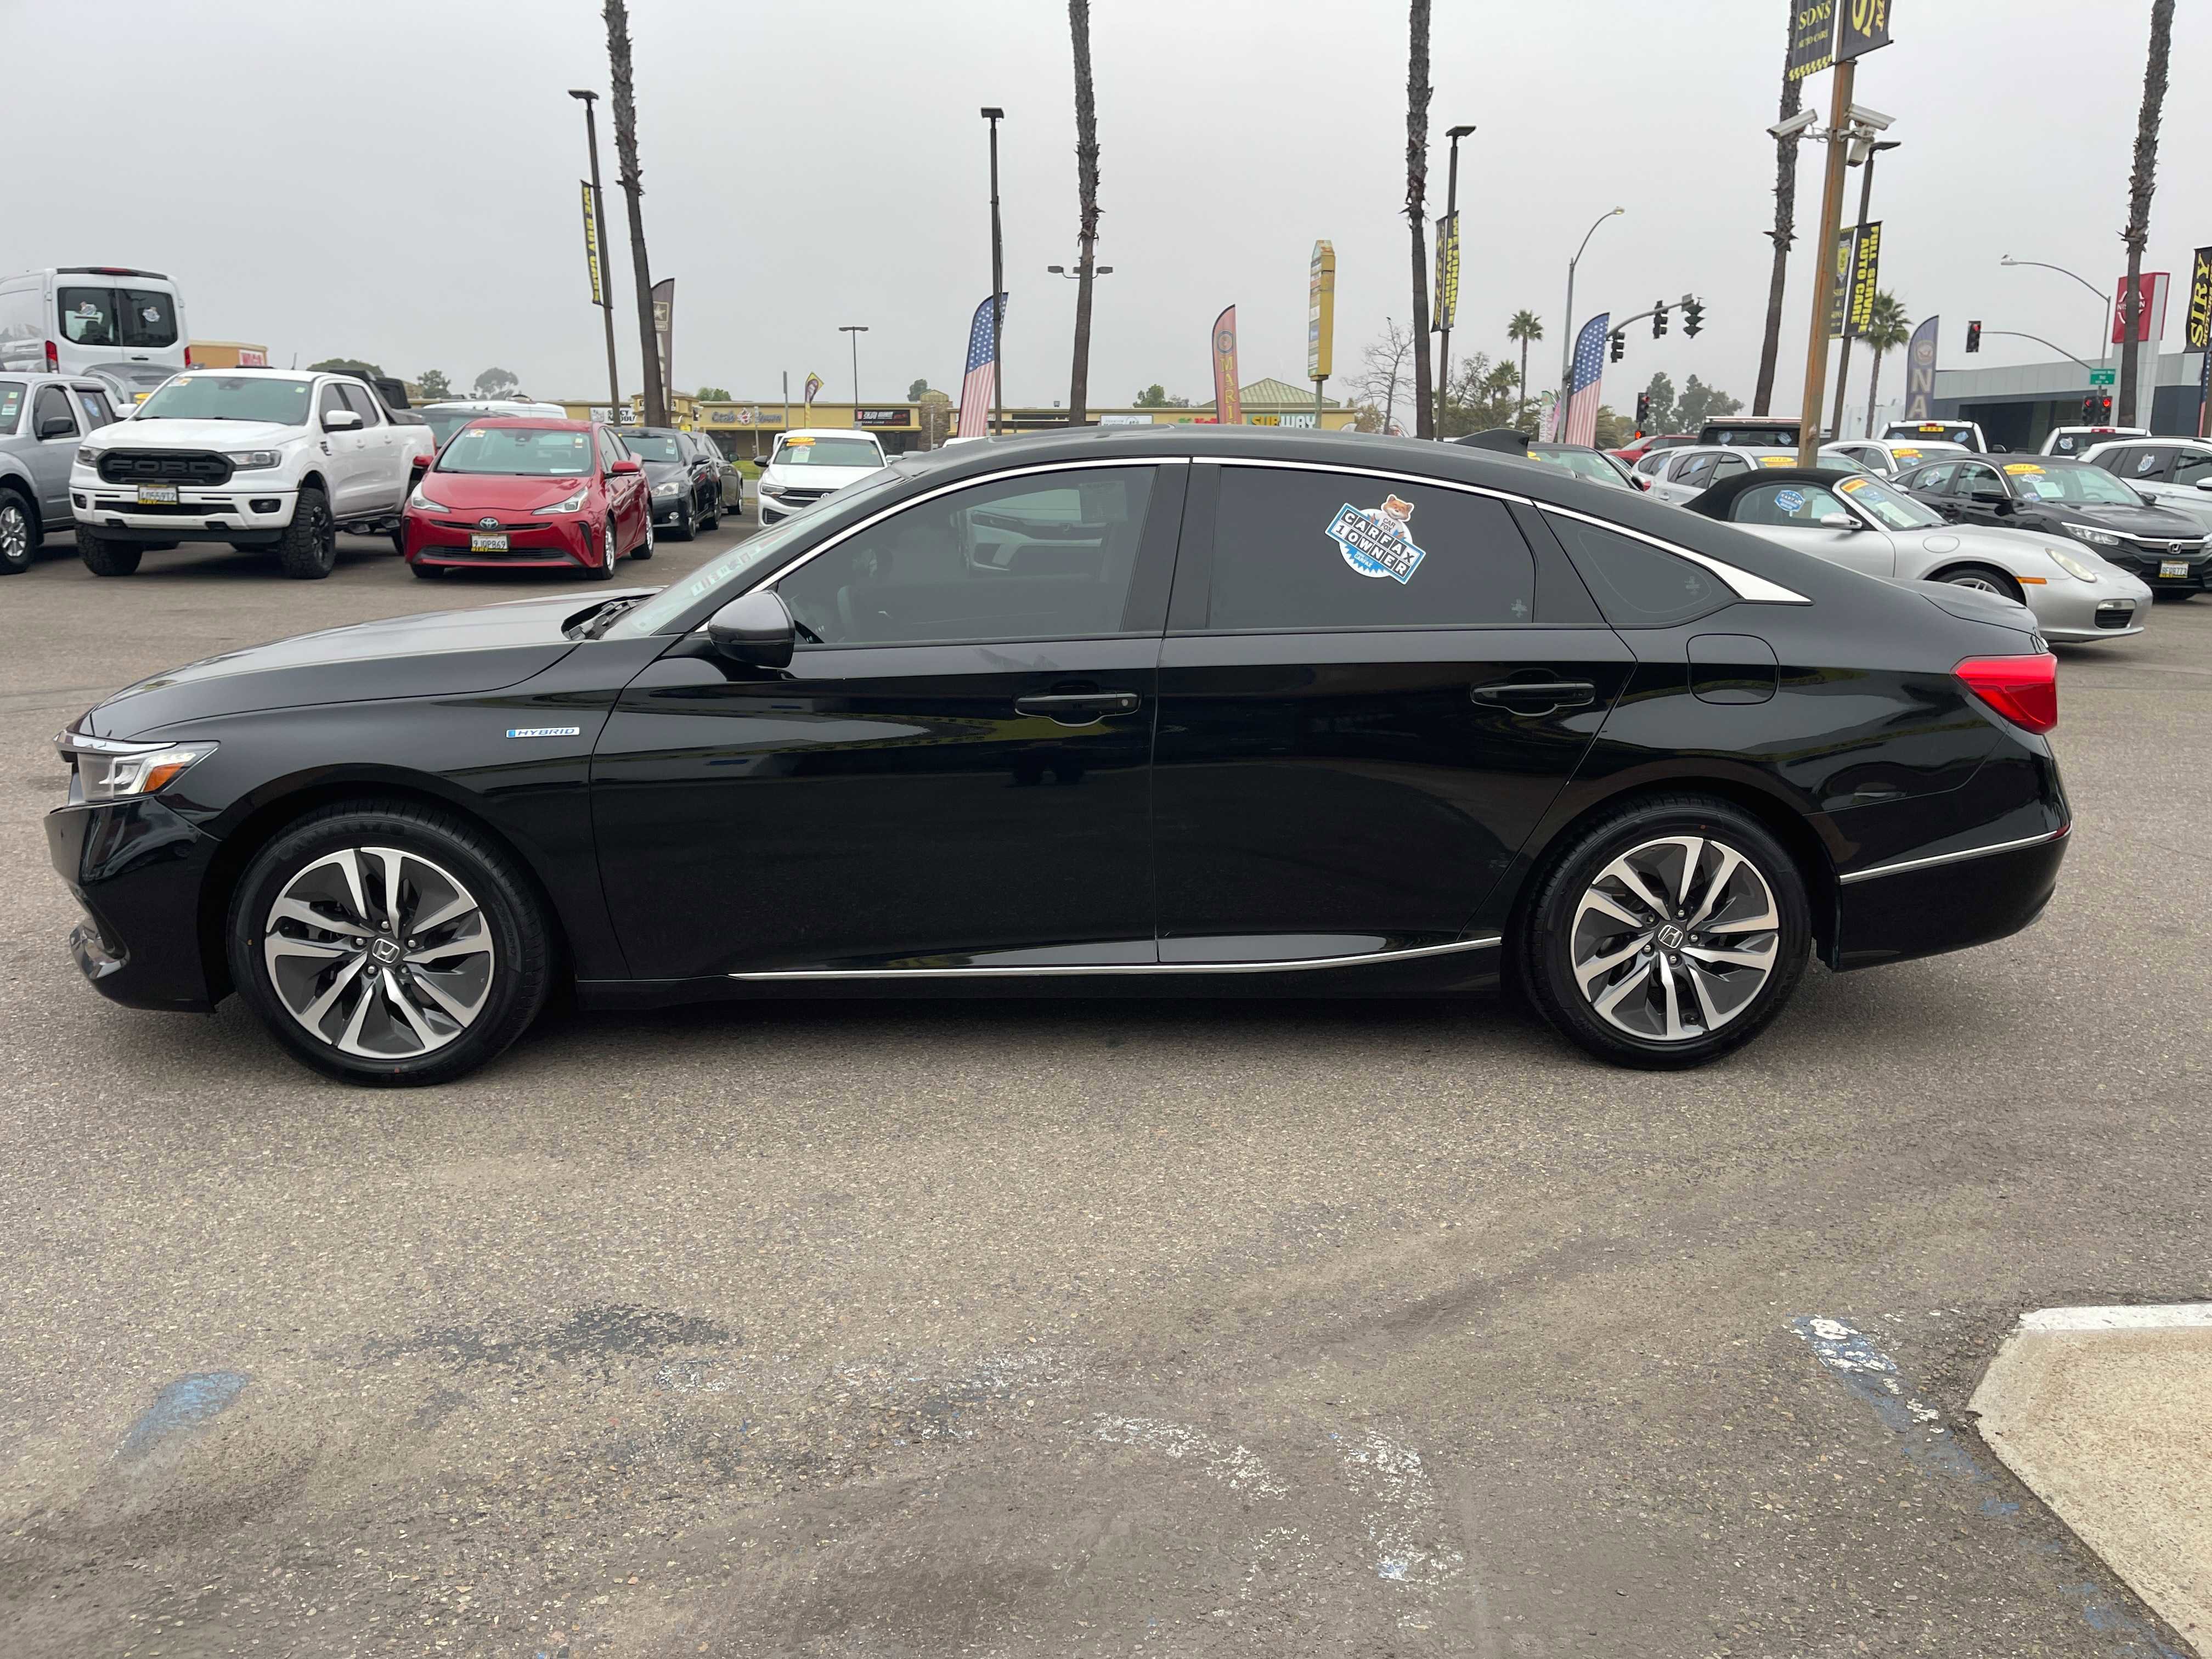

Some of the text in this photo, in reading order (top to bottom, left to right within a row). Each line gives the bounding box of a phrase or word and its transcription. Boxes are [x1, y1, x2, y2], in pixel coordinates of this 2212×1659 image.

[1798, 1, 1831, 30] SONS
[1448, 249, 1459, 324] FINANCE
[1850, 238, 1869, 324] AUTO CARE
[1858, 225, 1879, 332] FULL SERVICE
[2117, 301, 2145, 310] NISN
[2190, 252, 2209, 348] SIRY
[1214, 356, 1238, 425] MARI
[1251, 415, 1316, 428] SUBWAY
[107, 459, 226, 474] FORD
[1344, 512, 1415, 563] CARFAX
[1380, 523, 1392, 533] FOX
[1383, 518, 1396, 527] CAR
[1335, 524, 1345, 535] 1
[1347, 532, 1407, 575] OWNER
[1353, 553, 1373, 568] CARFAX
